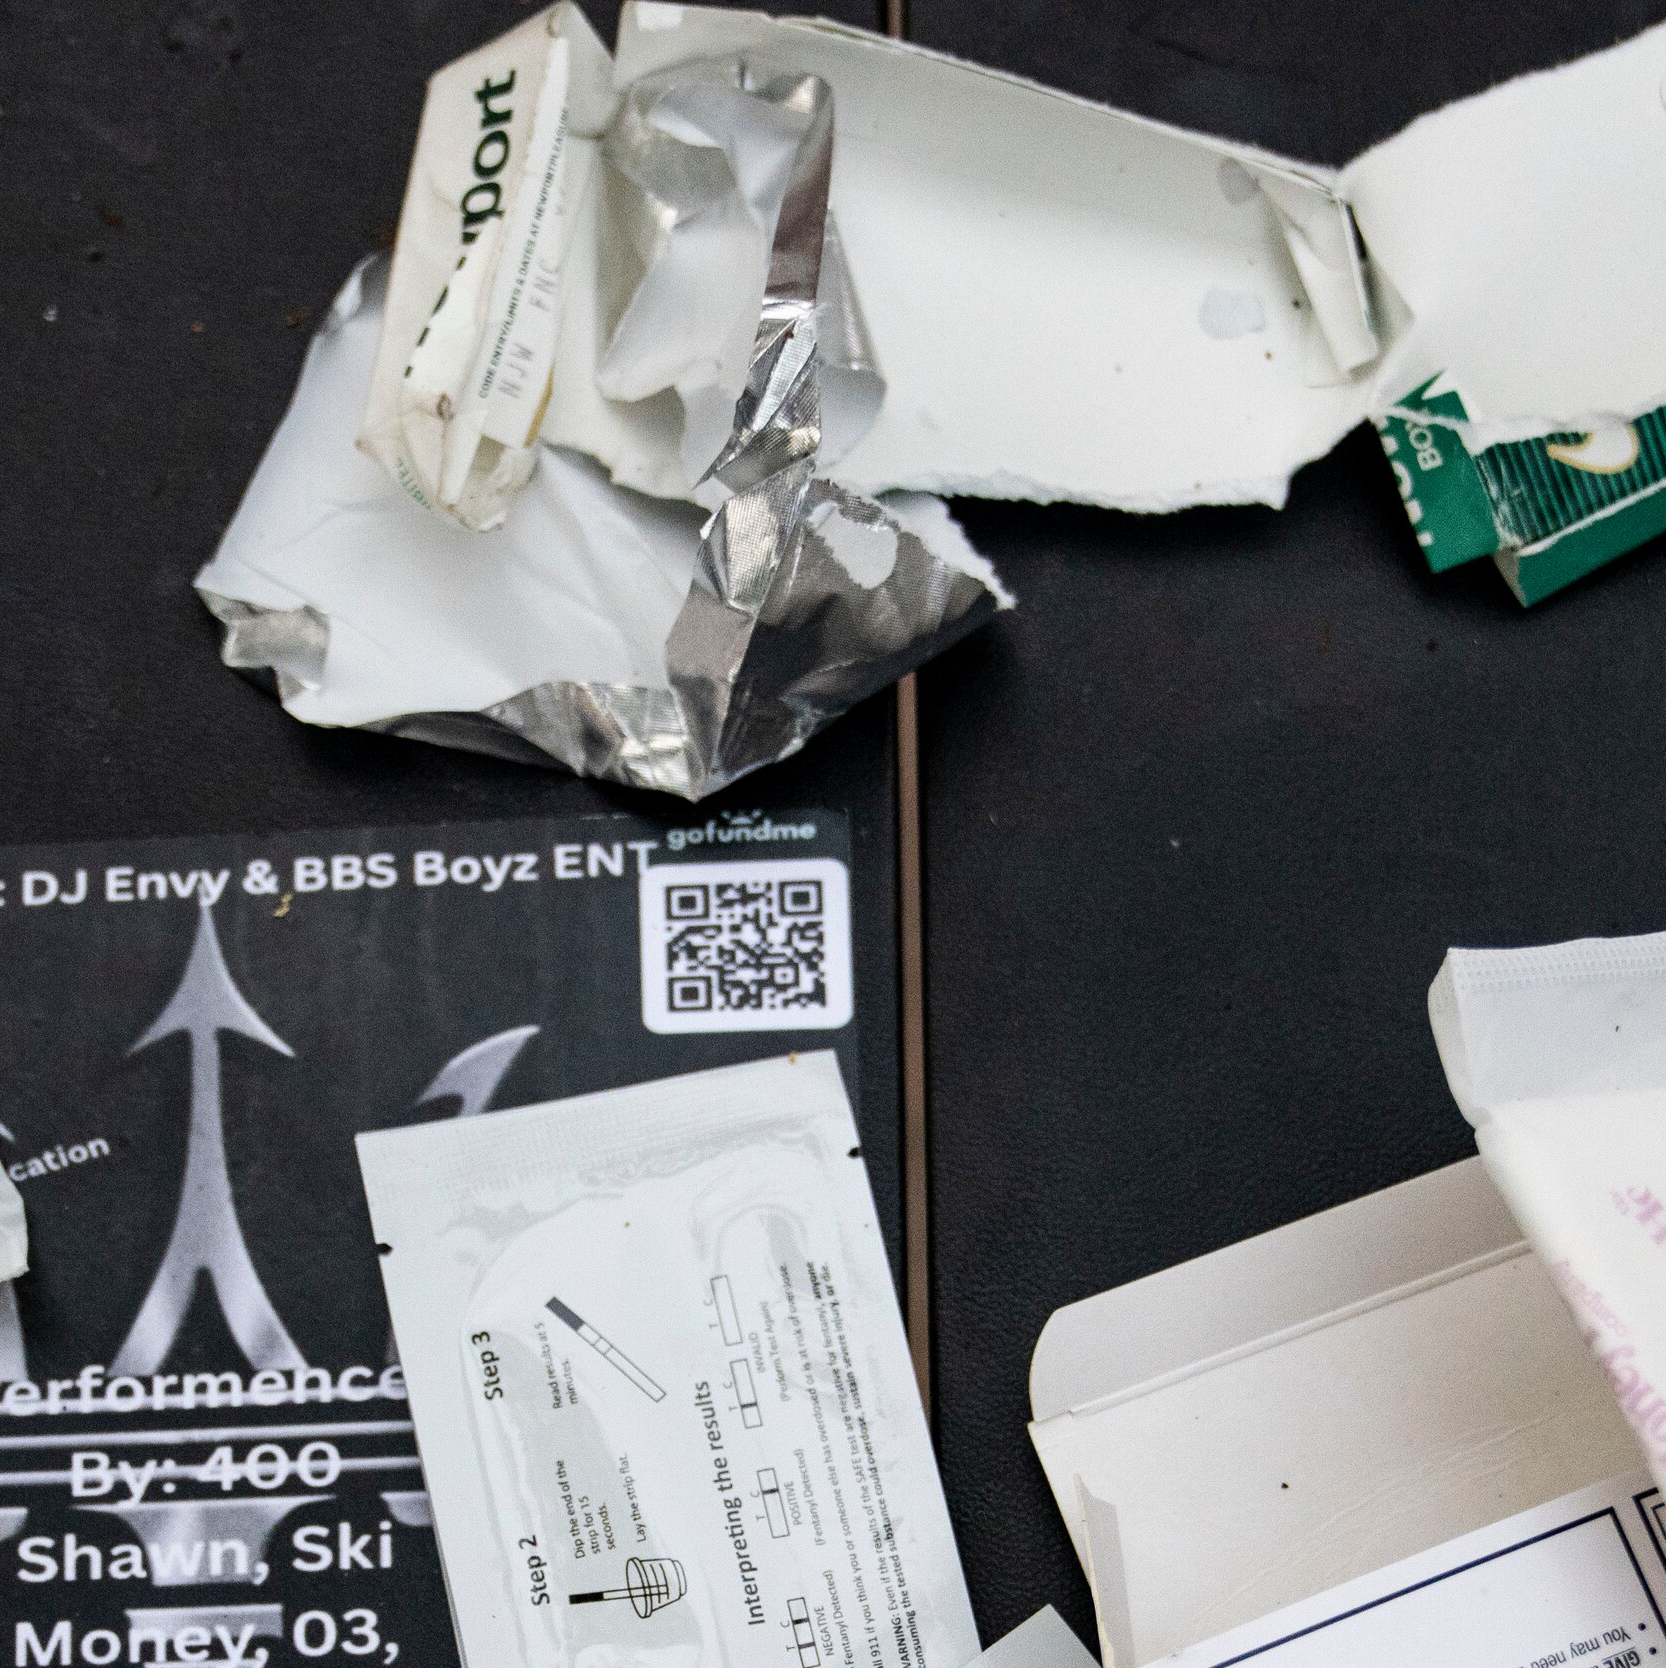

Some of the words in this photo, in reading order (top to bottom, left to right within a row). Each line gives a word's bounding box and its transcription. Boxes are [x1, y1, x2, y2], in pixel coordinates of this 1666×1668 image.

[664, 814, 817, 851] gofundme
[12, 863, 98, 915] DJ
[97, 856, 235, 911] Envy
[234, 854, 287, 905] &
[285, 848, 405, 902] BBS
[403, 842, 546, 897] Boyz
[545, 836, 661, 890] ENT
[7, 1130, 111, 1187] cation
[693, 1380, 724, 1451] results
[68, 1446, 188, 1502] By:
[187, 1439, 343, 1497] 400
[712, 1457, 734, 1494] the
[15, 1523, 279, 1590] Shawn,
[277, 1519, 397, 1579] Ski
[722, 1496, 766, 1627] Interpreting
